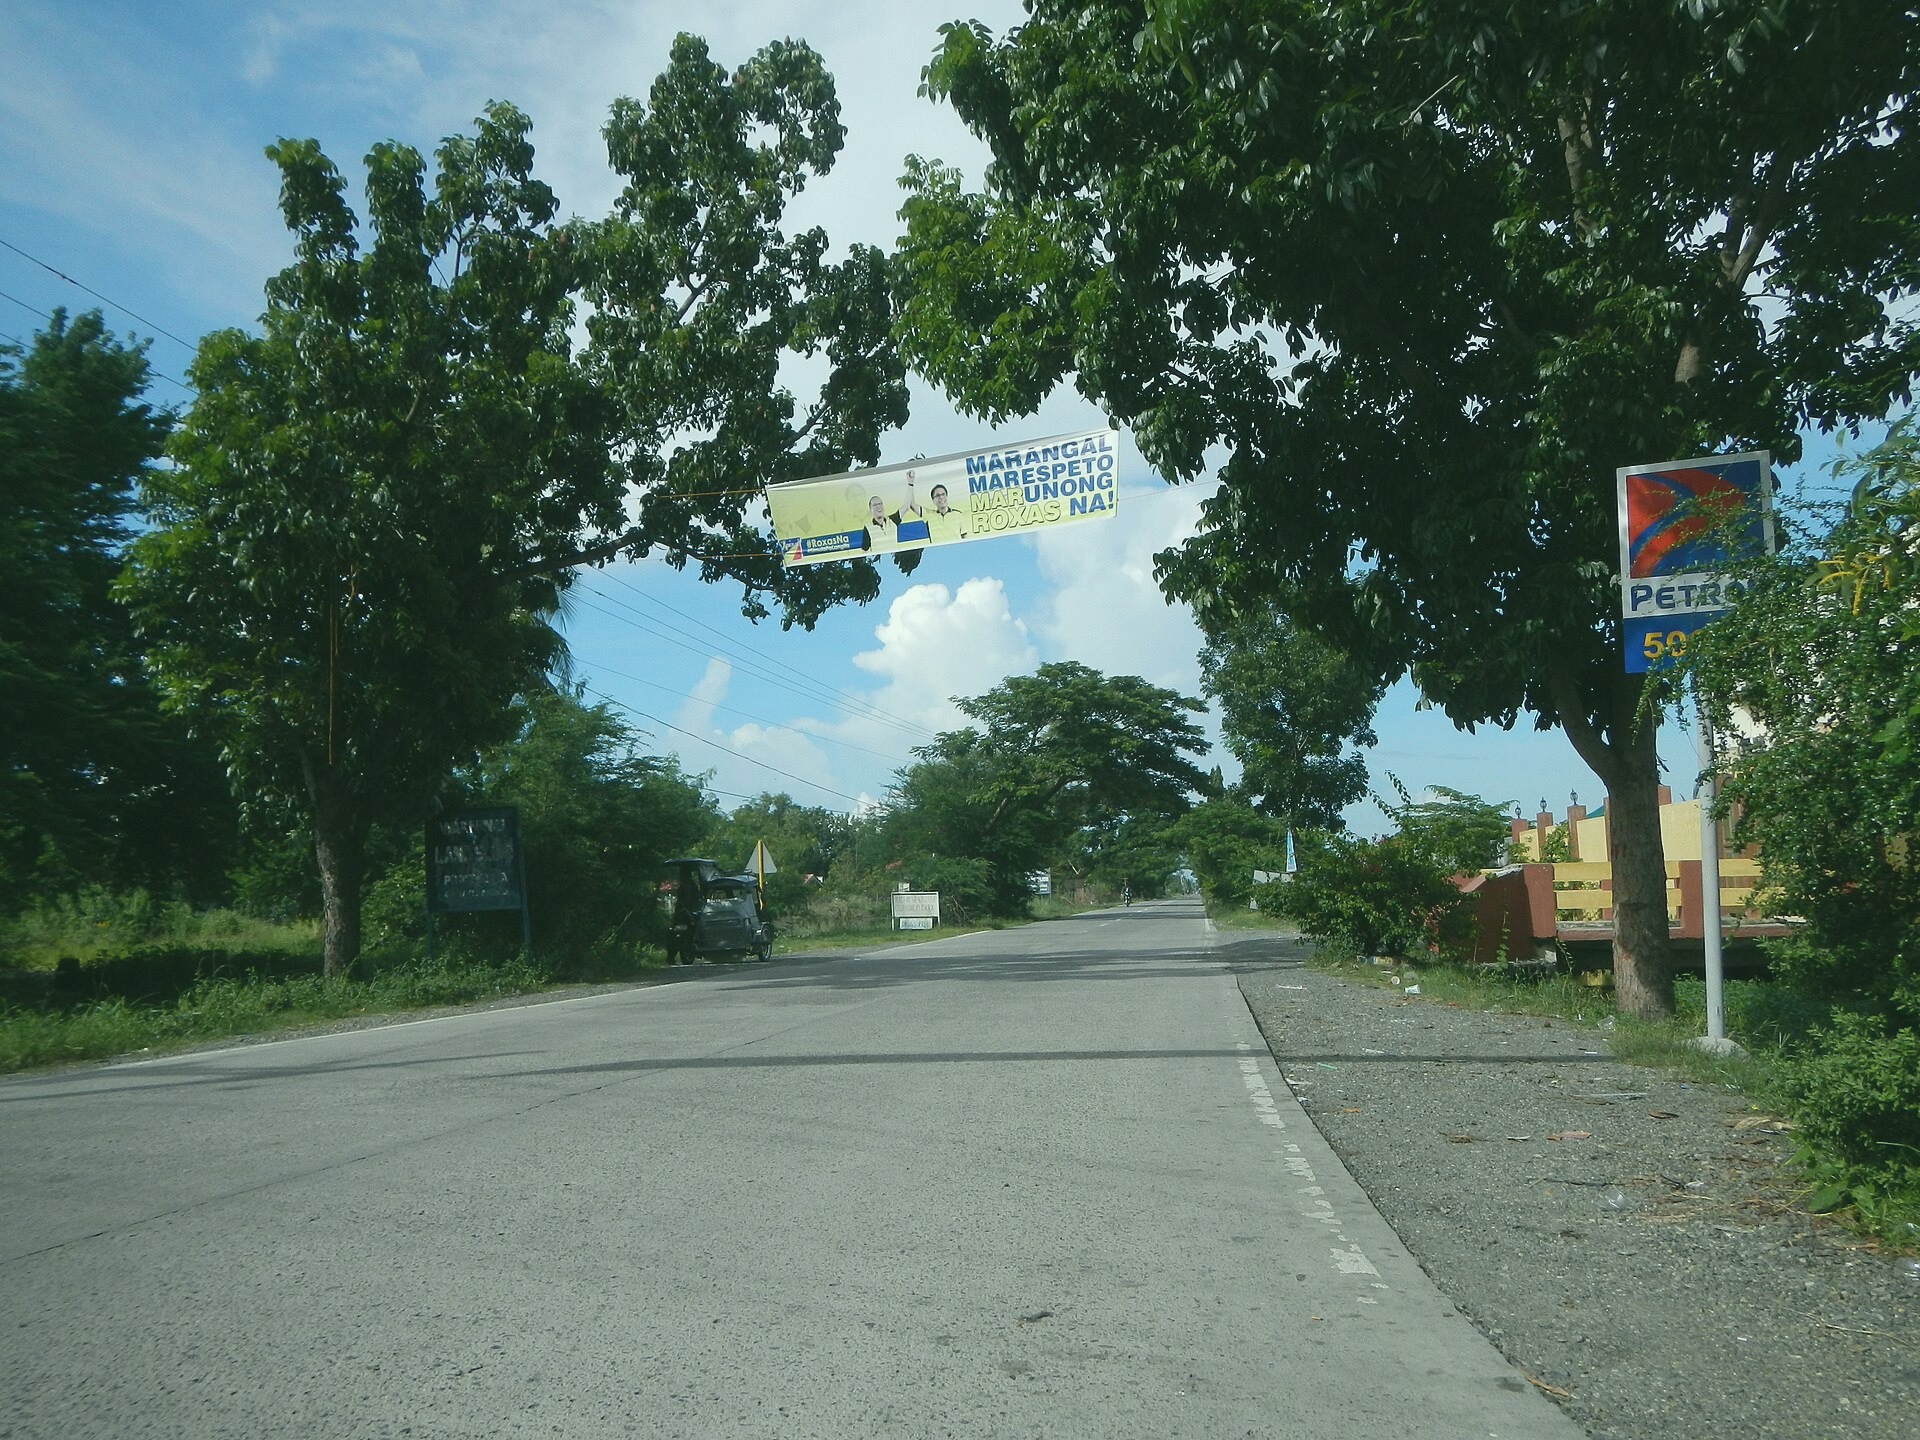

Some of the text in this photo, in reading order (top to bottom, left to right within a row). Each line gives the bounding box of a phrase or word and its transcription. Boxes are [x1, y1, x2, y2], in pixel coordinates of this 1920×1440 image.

[966, 434, 1112, 476] MARANGAL
[968, 454, 1113, 493] MARESPETO
[970, 472, 1113, 513] MARUNONG
[971, 490, 1114, 534] ROXAS NA!
[806, 534, 850, 549] #RoxasNa
[1630, 579, 1756, 612] PETRO
[1643, 629, 1702, 659] 50
